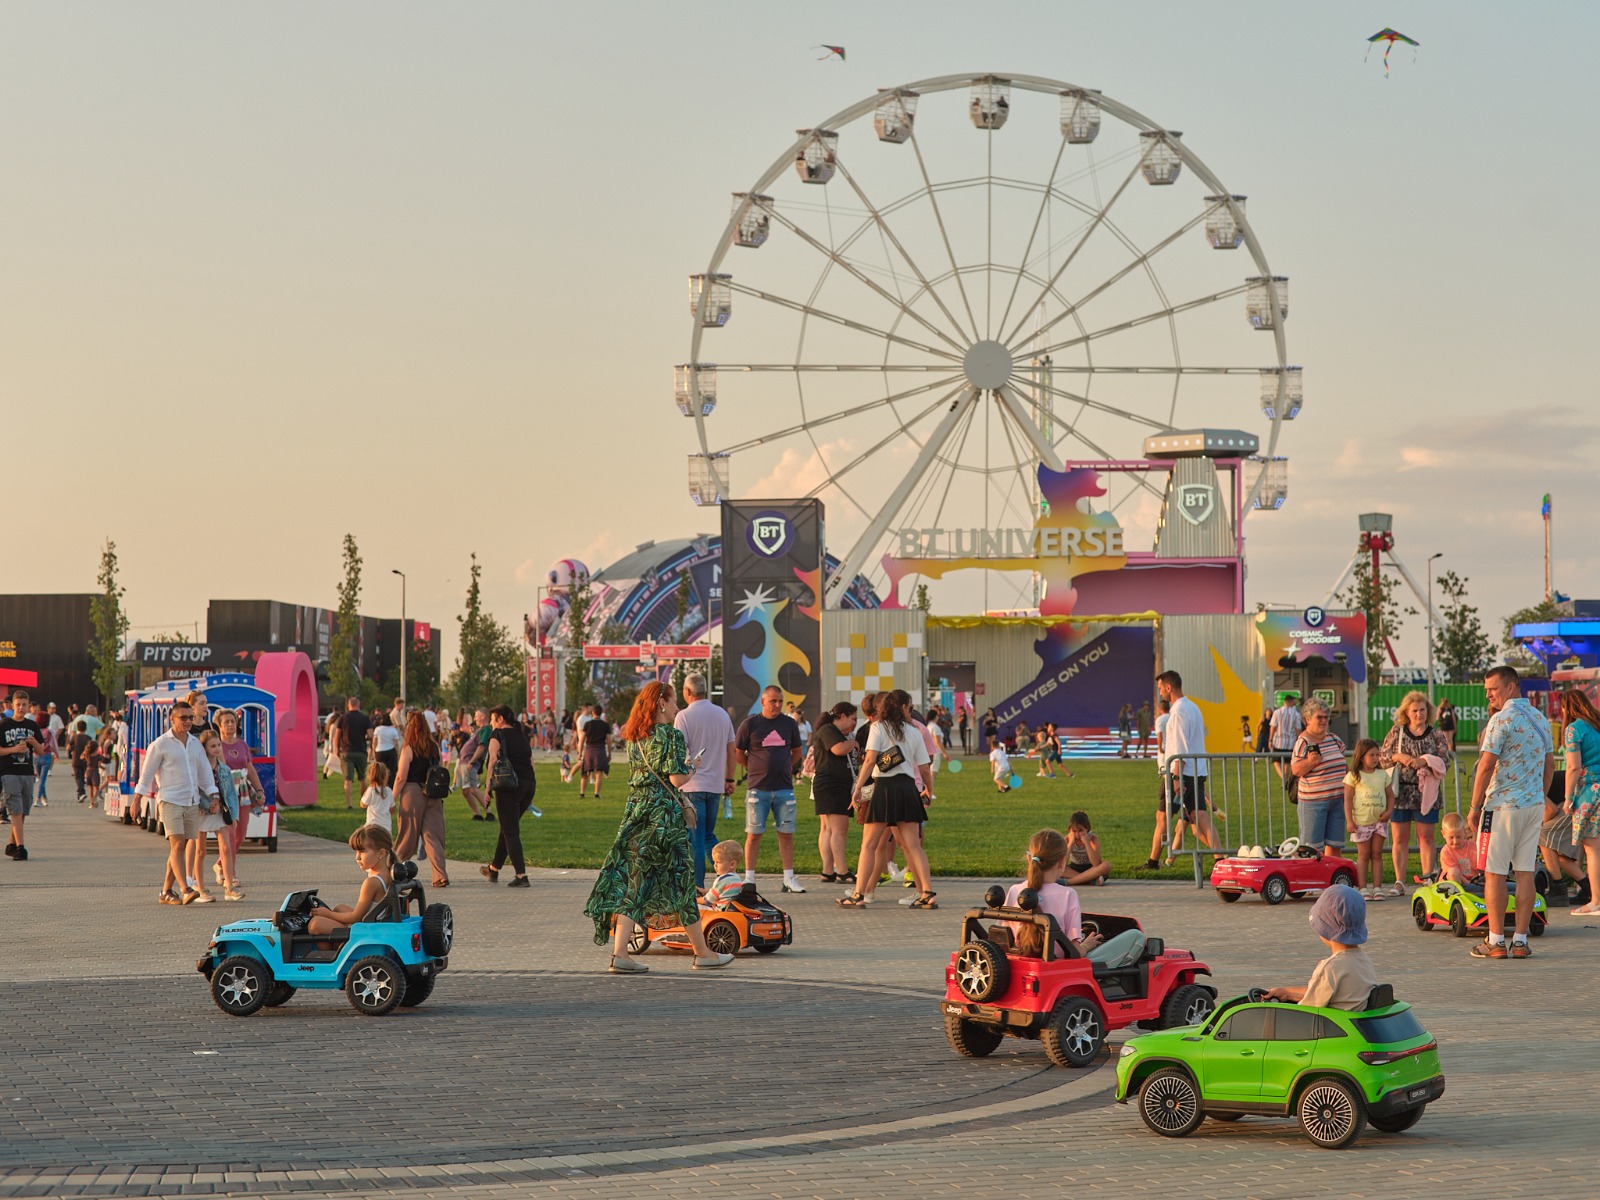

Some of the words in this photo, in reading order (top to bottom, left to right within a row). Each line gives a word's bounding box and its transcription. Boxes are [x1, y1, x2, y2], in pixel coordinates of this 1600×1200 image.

[1185, 493, 1207, 507] BT
[759, 525, 779, 538] BT
[900, 528, 944, 556] BT
[955, 527, 1124, 557] UNIVERSE
[1289, 630, 1324, 638] COSMIC
[1302, 636, 1342, 644] GOODIES
[143, 646, 170, 661] PIT
[171, 646, 212, 661] STOP
[997, 706, 1021, 724] ALL
[1020, 678, 1058, 709] EYES
[1058, 663, 1080, 683] ON
[1079, 642, 1110, 667] YOU
[1373, 706, 1398, 721] IT'S
[1455, 706, 1490, 721] RESH
[297, 964, 315, 973] Jeep
[946, 1004, 962, 1016] Jeep
